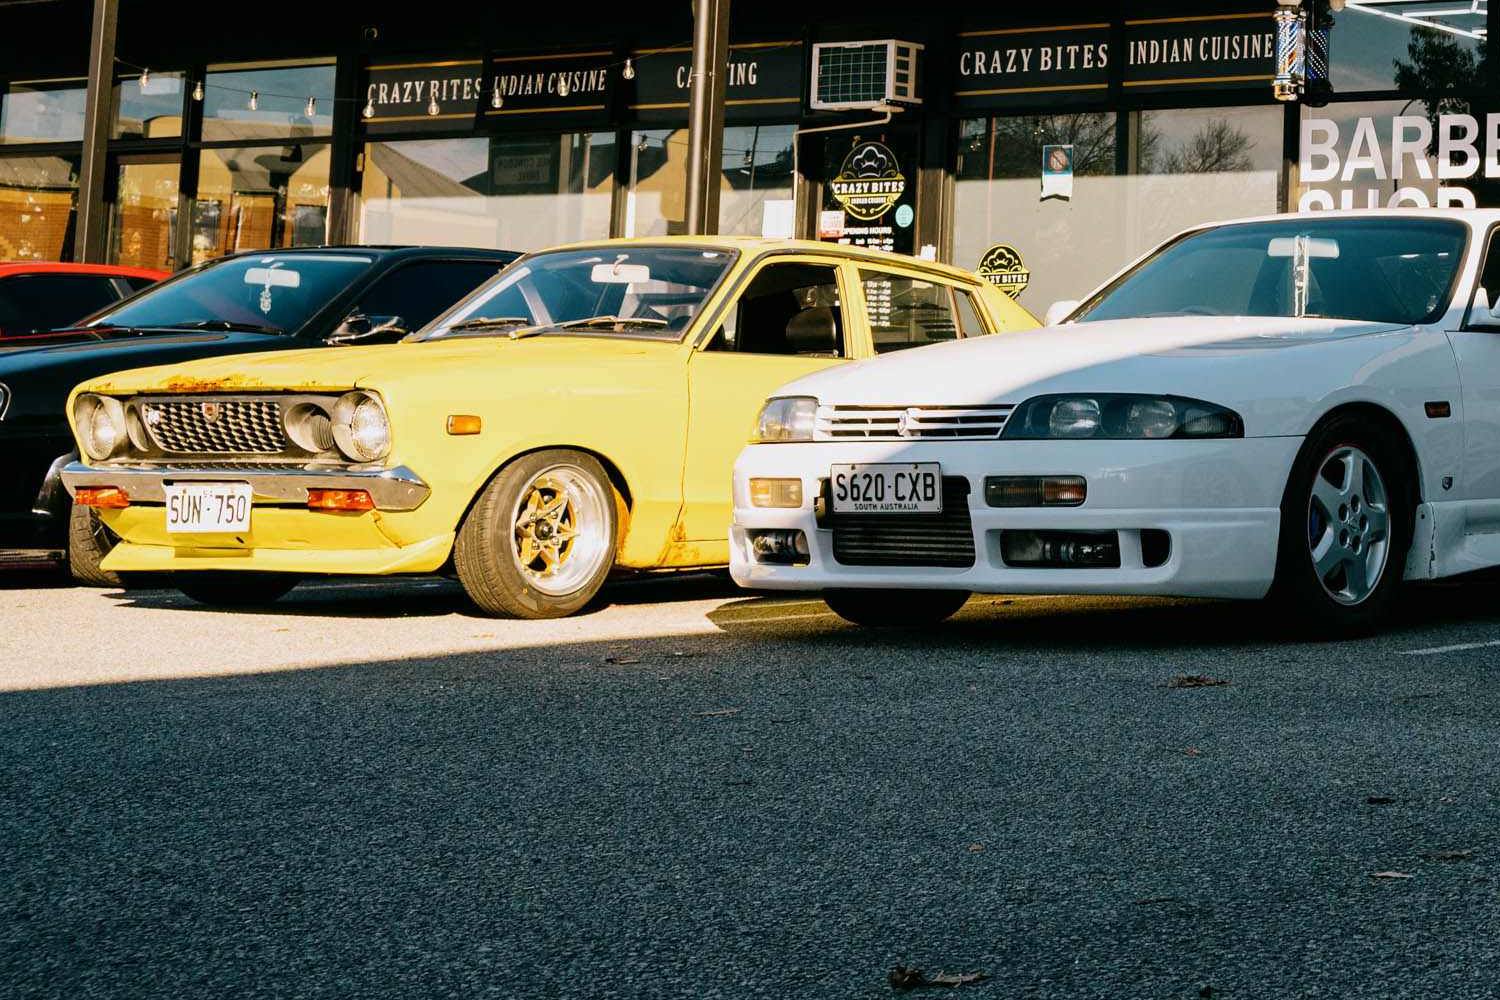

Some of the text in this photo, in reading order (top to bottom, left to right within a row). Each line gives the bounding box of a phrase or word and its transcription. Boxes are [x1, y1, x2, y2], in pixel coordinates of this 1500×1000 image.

[960, 33, 1274, 76] CRAZY BITES INDIAN CUISINE
[367, 81, 425, 104] CRAZY
[430, 77, 482, 101] BITES
[494, 73, 545, 96] INDIAN
[834, 181, 905, 194] CRAZY BITES
[1002, 274, 1028, 283] BITES
[854, 503, 919, 511] SOUTH AUSTRALIA
